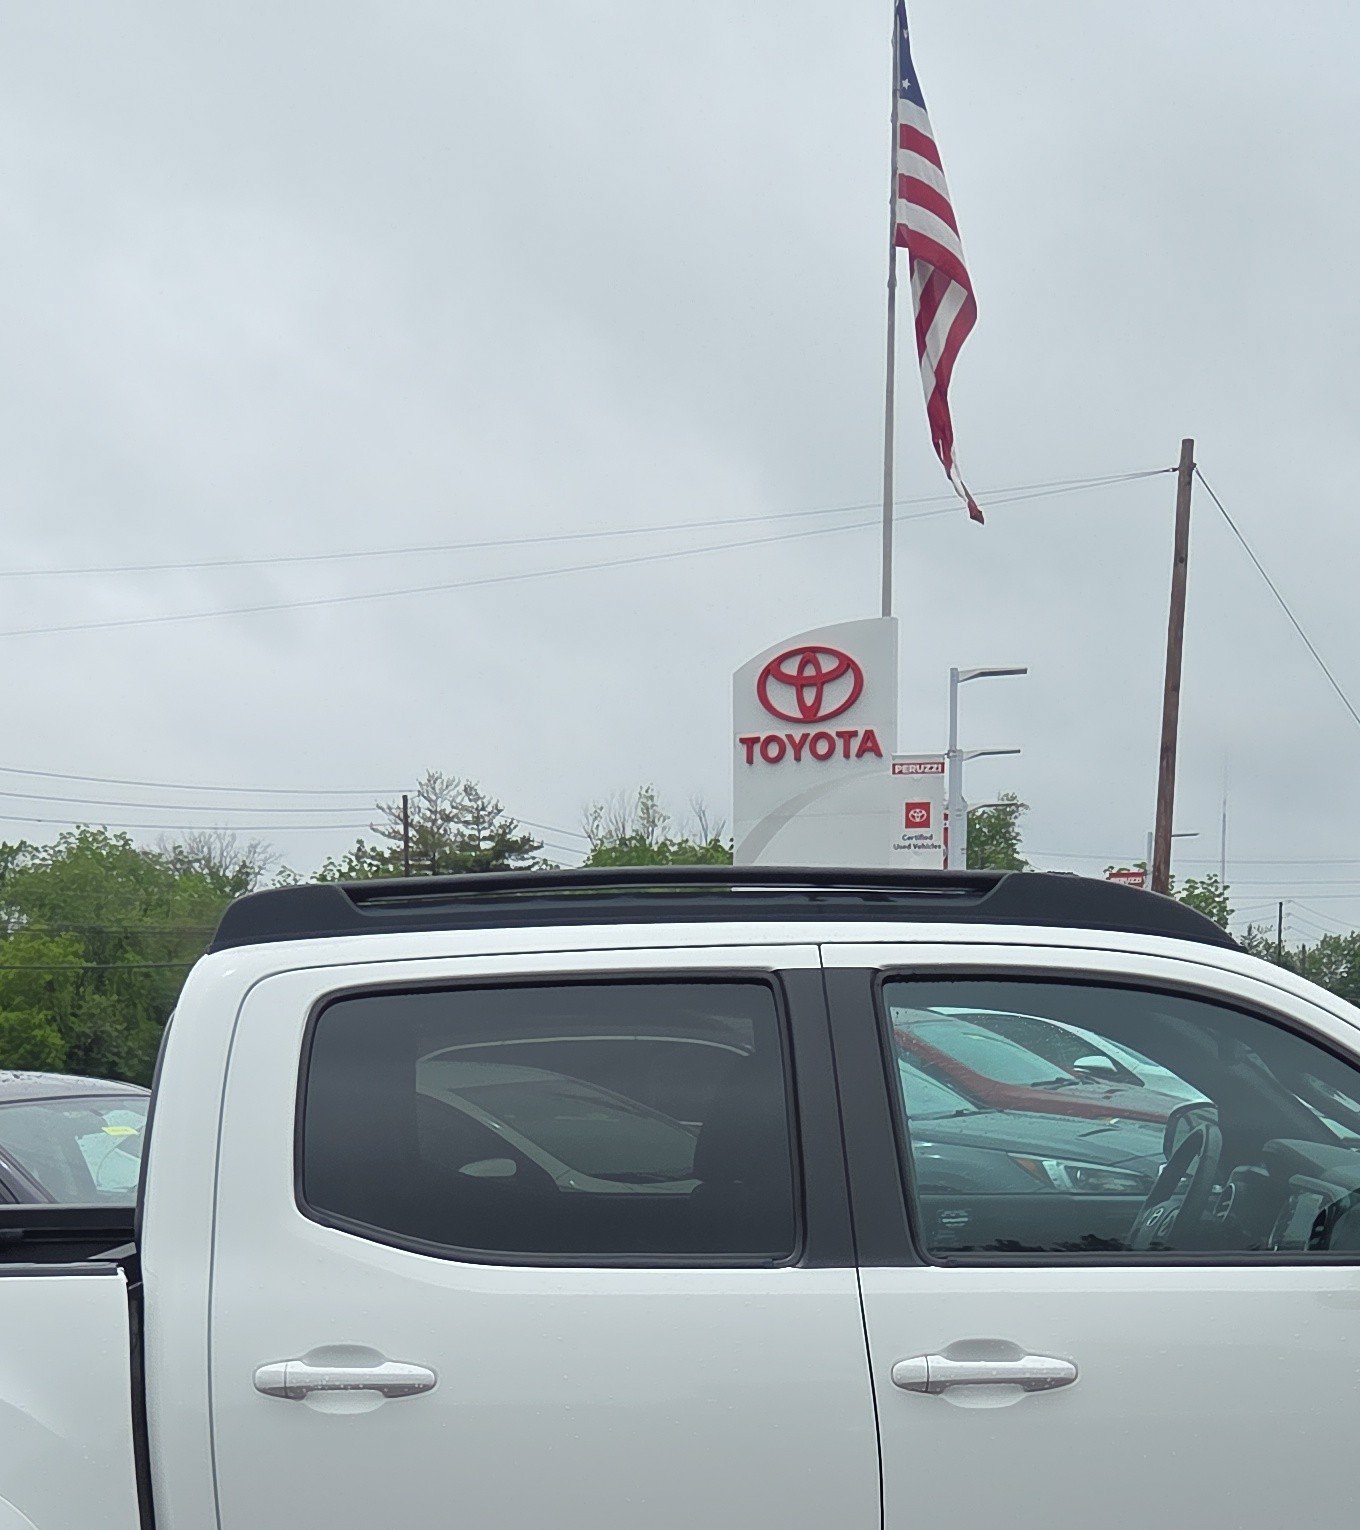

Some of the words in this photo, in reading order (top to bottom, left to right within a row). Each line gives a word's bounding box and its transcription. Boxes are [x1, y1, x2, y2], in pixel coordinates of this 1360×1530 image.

[739, 729, 883, 765] TOYOTA
[894, 763, 942, 774] PERUZZI
[901, 833, 934, 842] Certified
[893, 842, 912, 851] Used
[912, 841, 942, 851] Vehicles
